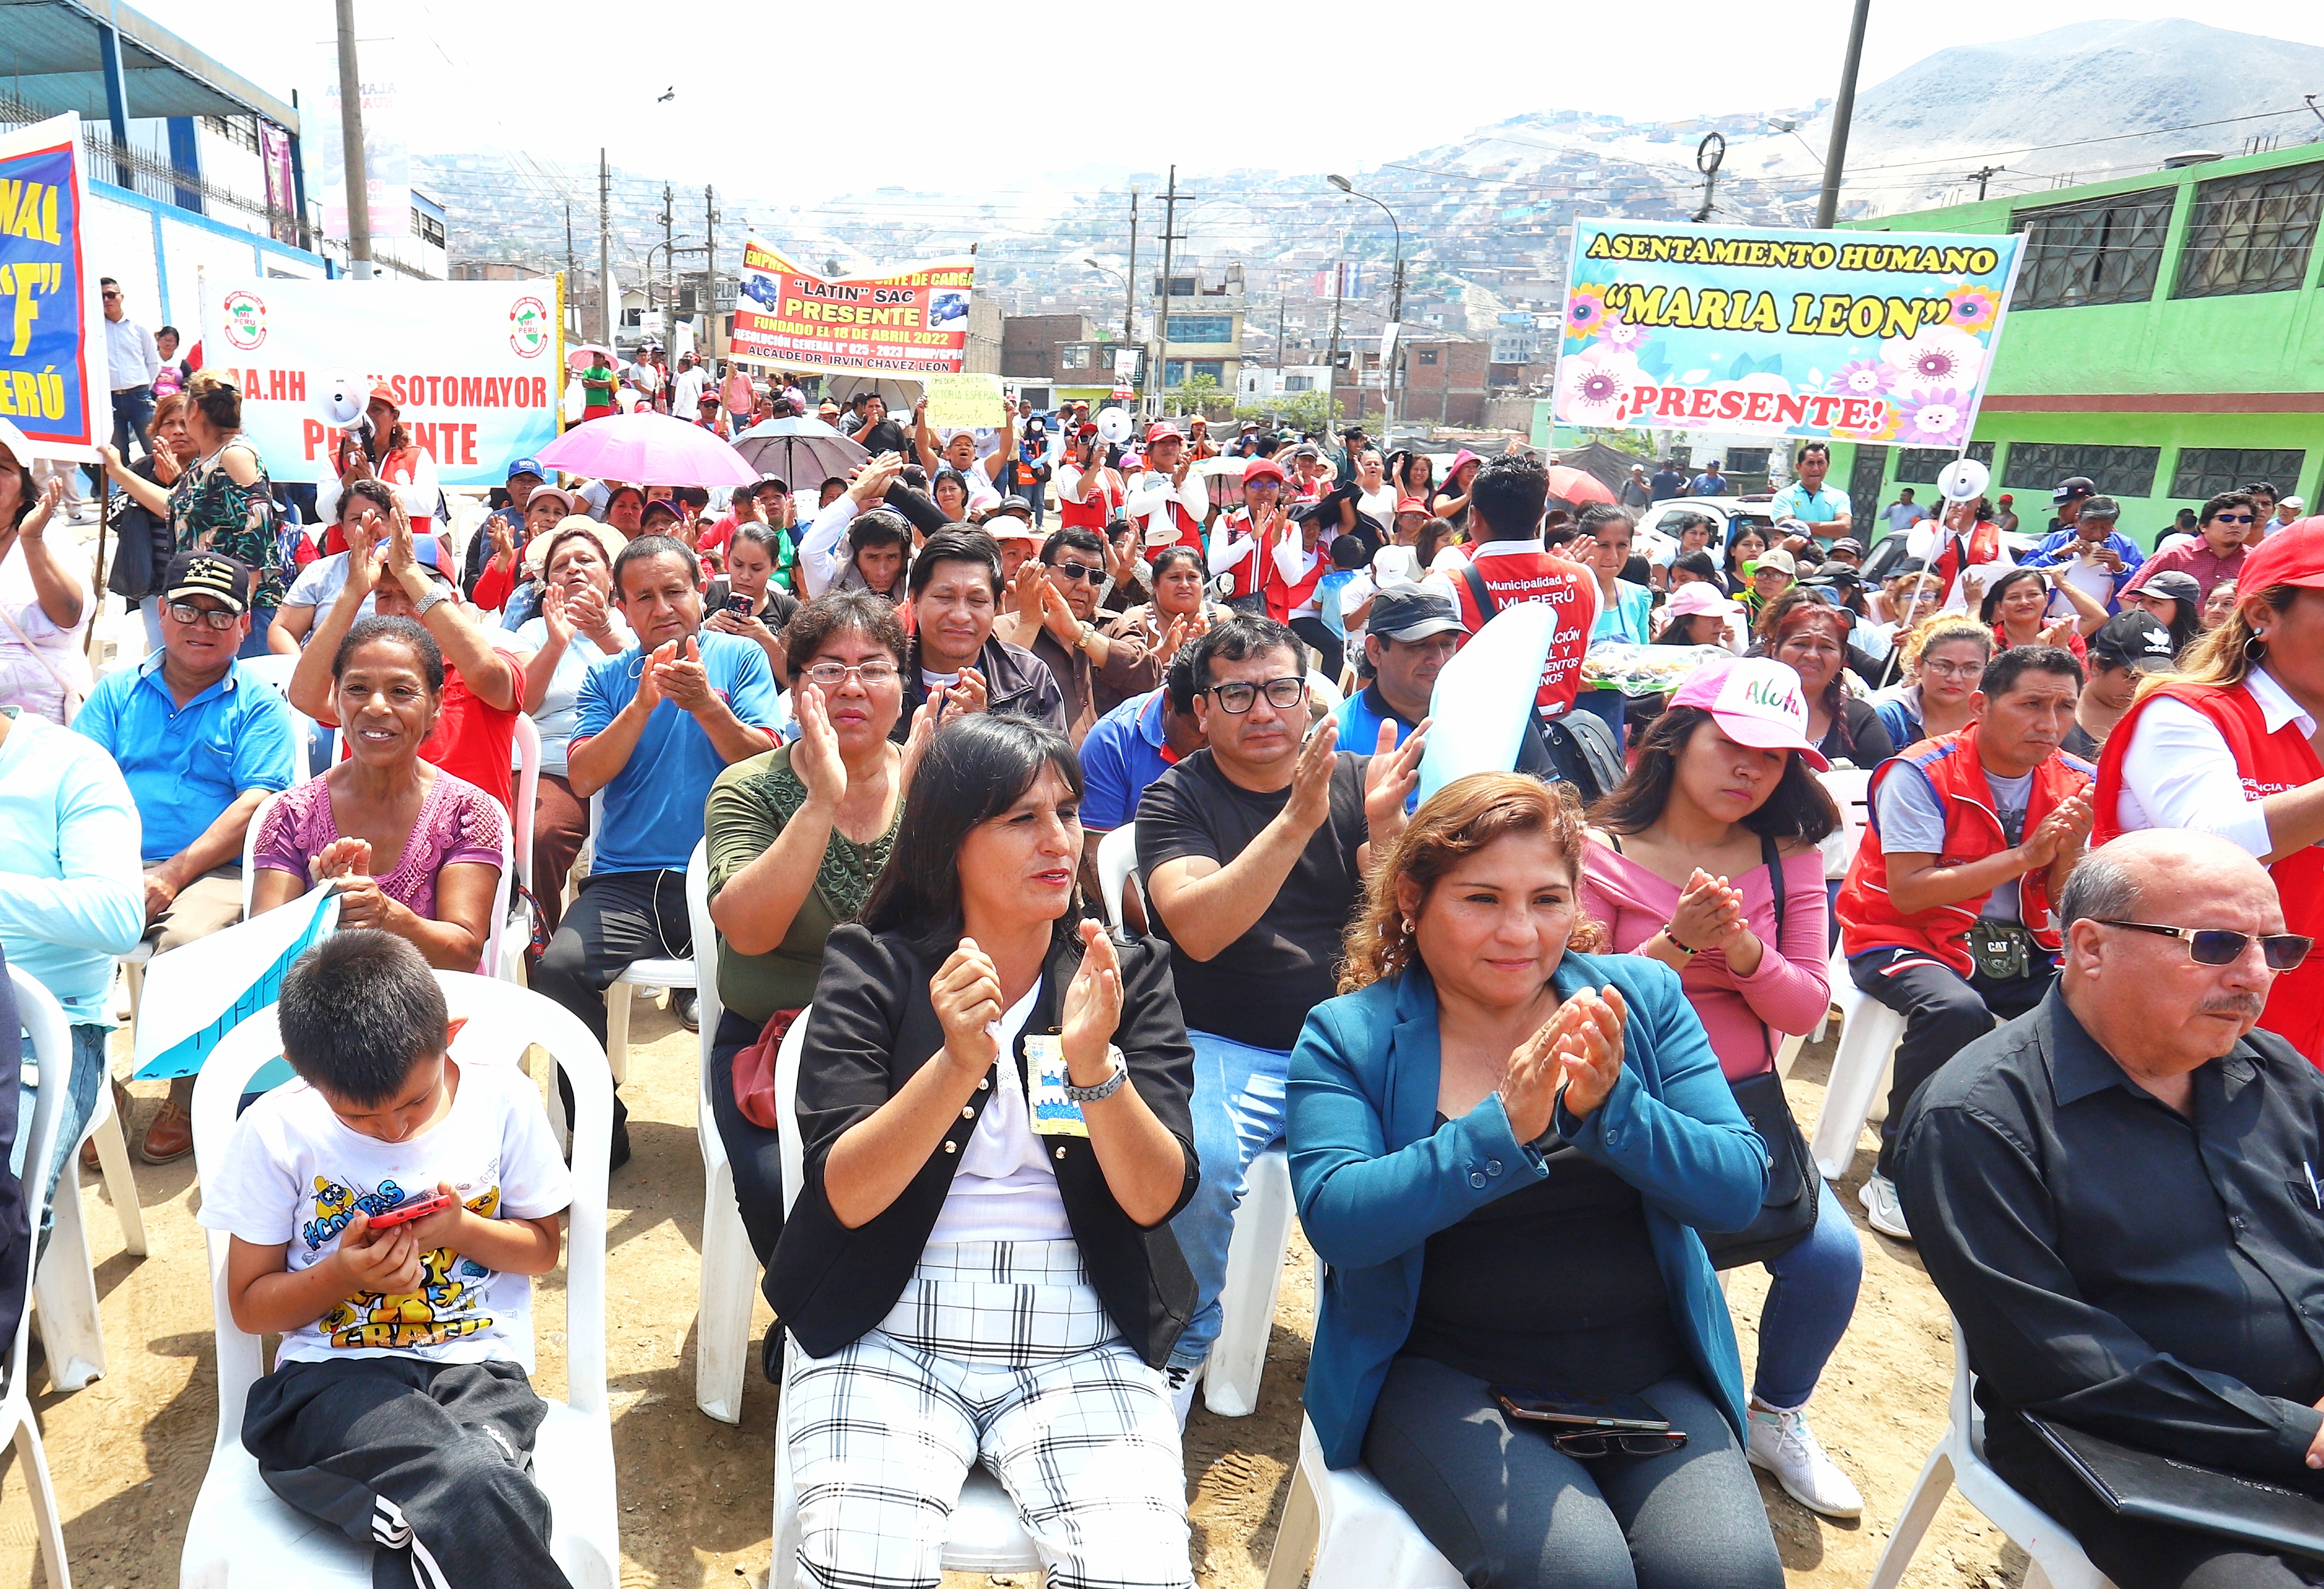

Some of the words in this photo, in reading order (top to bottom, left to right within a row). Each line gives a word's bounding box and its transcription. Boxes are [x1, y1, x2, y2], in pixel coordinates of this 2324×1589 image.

[1585, 232, 1837, 270] ASENTAMIENTO
[1837, 243, 1998, 275] HUMANO
[794, 279, 868, 301] “LATIN”
[875, 290, 914, 303] SAC
[911, 272, 929, 287] DE
[785, 297, 921, 327] PRESENTE
[1604, 283, 1781, 332] “MARIA
[1787, 292, 1952, 340] LEON”
[733, 328, 791, 348] RESOLUCIÓN
[793, 338, 834, 353] GENERAL
[849, 343, 869, 355] 025
[876, 345, 903, 358] 2023
[754, 316, 814, 336] FUNDADO
[816, 326, 830, 338] EL
[833, 326, 849, 339] 18
[852, 328, 868, 340] DE
[871, 329, 911, 343] ABRIL
[913, 332, 949, 345] 2022
[749, 346, 801, 361] ALCALDE
[806, 354, 825, 364] DR.
[830, 356, 863, 367] IRVIN
[867, 358, 915, 371] CHAVEZ
[919, 362, 949, 372] LEON
[391, 375, 546, 408] SOTOMAYOR
[927, 390, 961, 399] VICTORIA
[931, 405, 984, 423] Presente
[1616, 386, 1884, 430] ¡PRESENTE!
[1485, 574, 1562, 591] Municipalidad
[1565, 573, 1577, 583] de
[1987, 942, 2008, 953] CAT
